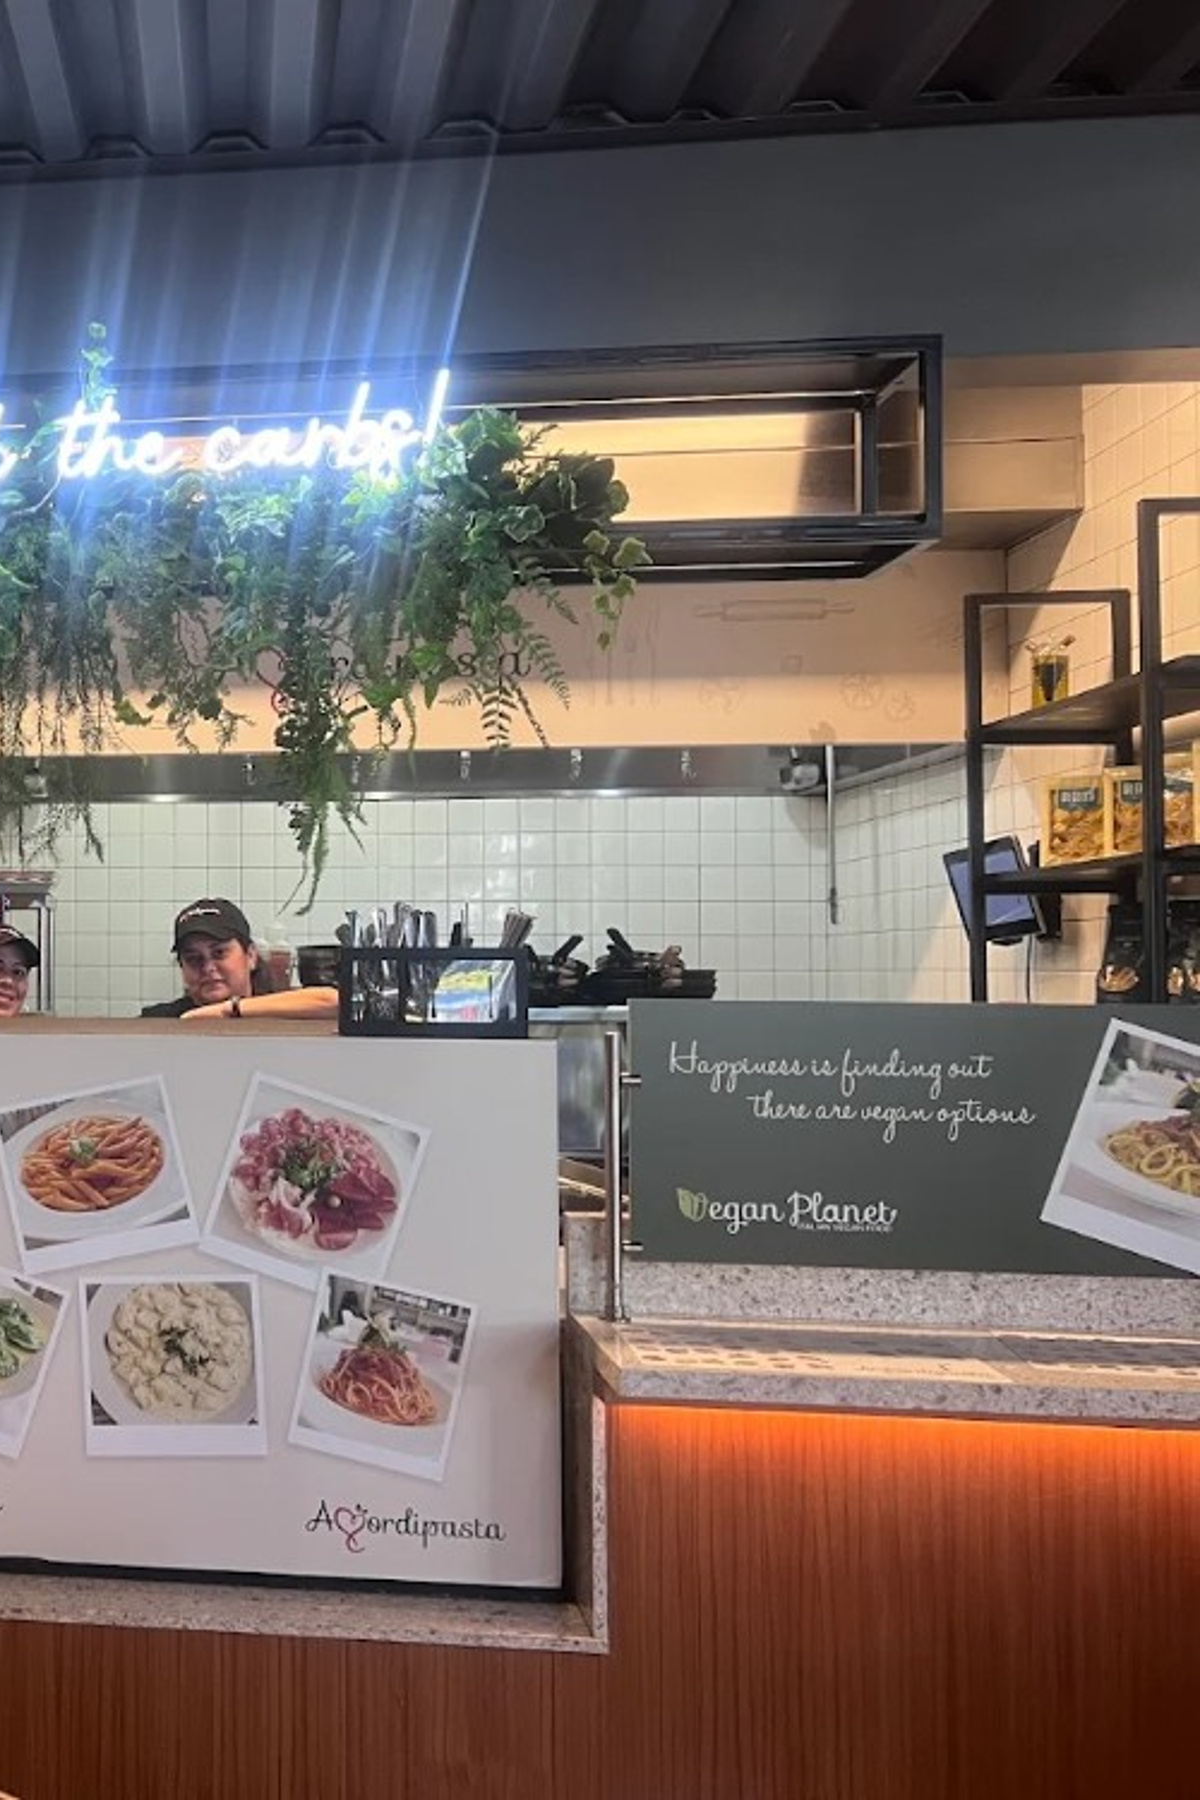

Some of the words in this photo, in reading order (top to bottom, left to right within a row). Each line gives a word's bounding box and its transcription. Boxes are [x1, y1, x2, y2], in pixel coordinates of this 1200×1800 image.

[57, 396, 183, 478] the
[203, 368, 449, 484] carbs!
[668, 1040, 808, 1093] Happiness
[810, 1056, 839, 1078] is
[840, 1048, 943, 1099] finding
[948, 1055, 995, 1078] out
[746, 1089, 812, 1121] there
[814, 1103, 858, 1121] are
[860, 1104, 935, 1143] vegan
[936, 1099, 1037, 1141] options
[786, 1190, 899, 1228] Planet
